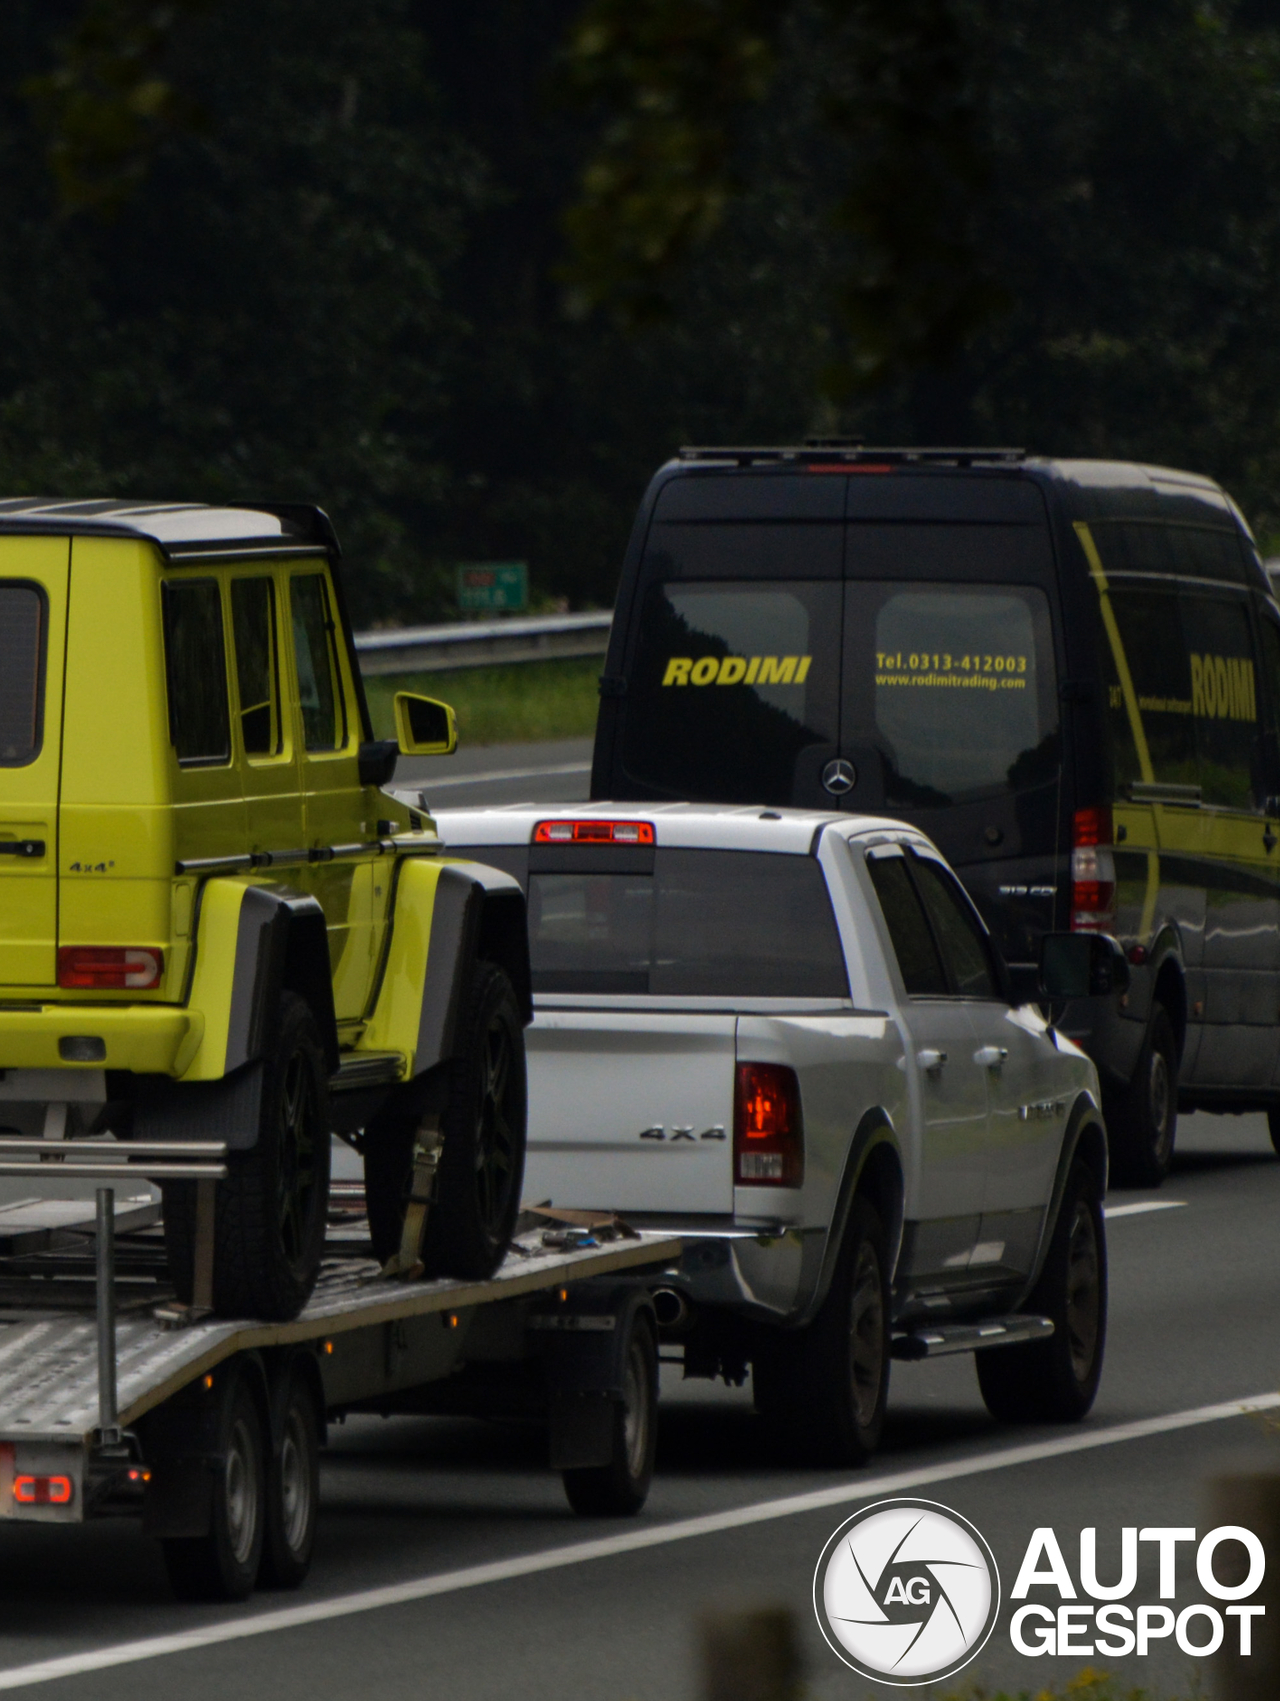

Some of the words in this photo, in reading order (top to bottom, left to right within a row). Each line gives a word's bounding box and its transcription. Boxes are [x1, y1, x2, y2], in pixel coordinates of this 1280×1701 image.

[662, 656, 812, 686] RODIMI
[876, 653, 1027, 673] Tel.0313-412003
[875, 673, 1026, 691] www.rodimitrading.com
[1190, 653, 1257, 723] RODIMI
